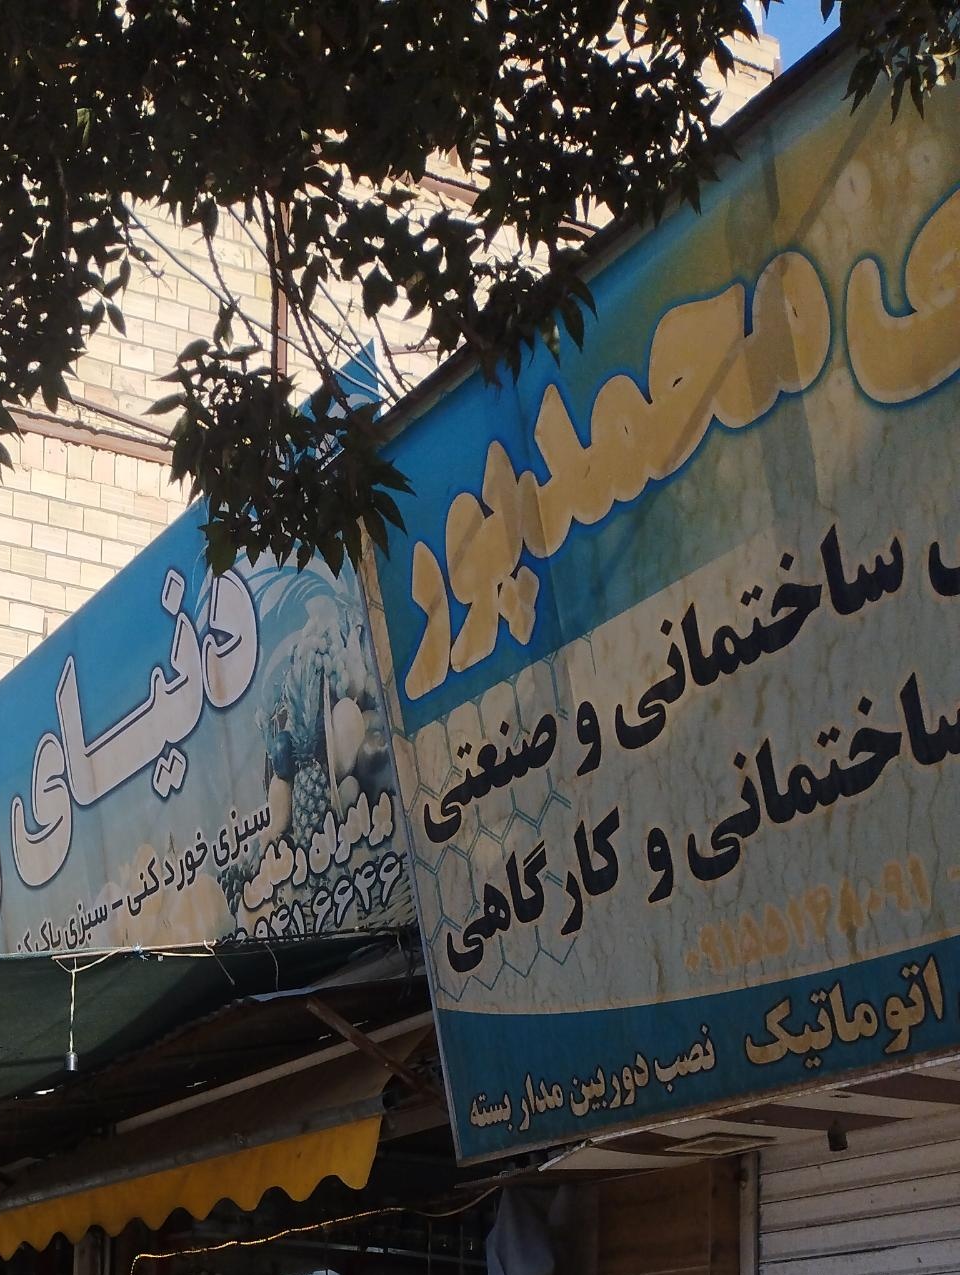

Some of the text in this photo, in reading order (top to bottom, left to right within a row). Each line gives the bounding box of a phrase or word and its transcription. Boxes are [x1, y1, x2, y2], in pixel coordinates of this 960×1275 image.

[615, 524, 903, 749] ساختمانی
[11, 568, 259, 888] دنیای
[424, 714, 557, 843] صنعتی
[576, 701, 602, 776] و
[213, 808, 271, 867] سبزی
[446, 806, 620, 973] کارگاهی
[646, 827, 674, 903] و
[65, 901, 108, 950] سبزی
[470, 1024, 716, 1132] نصب دوربین مدار بسته
